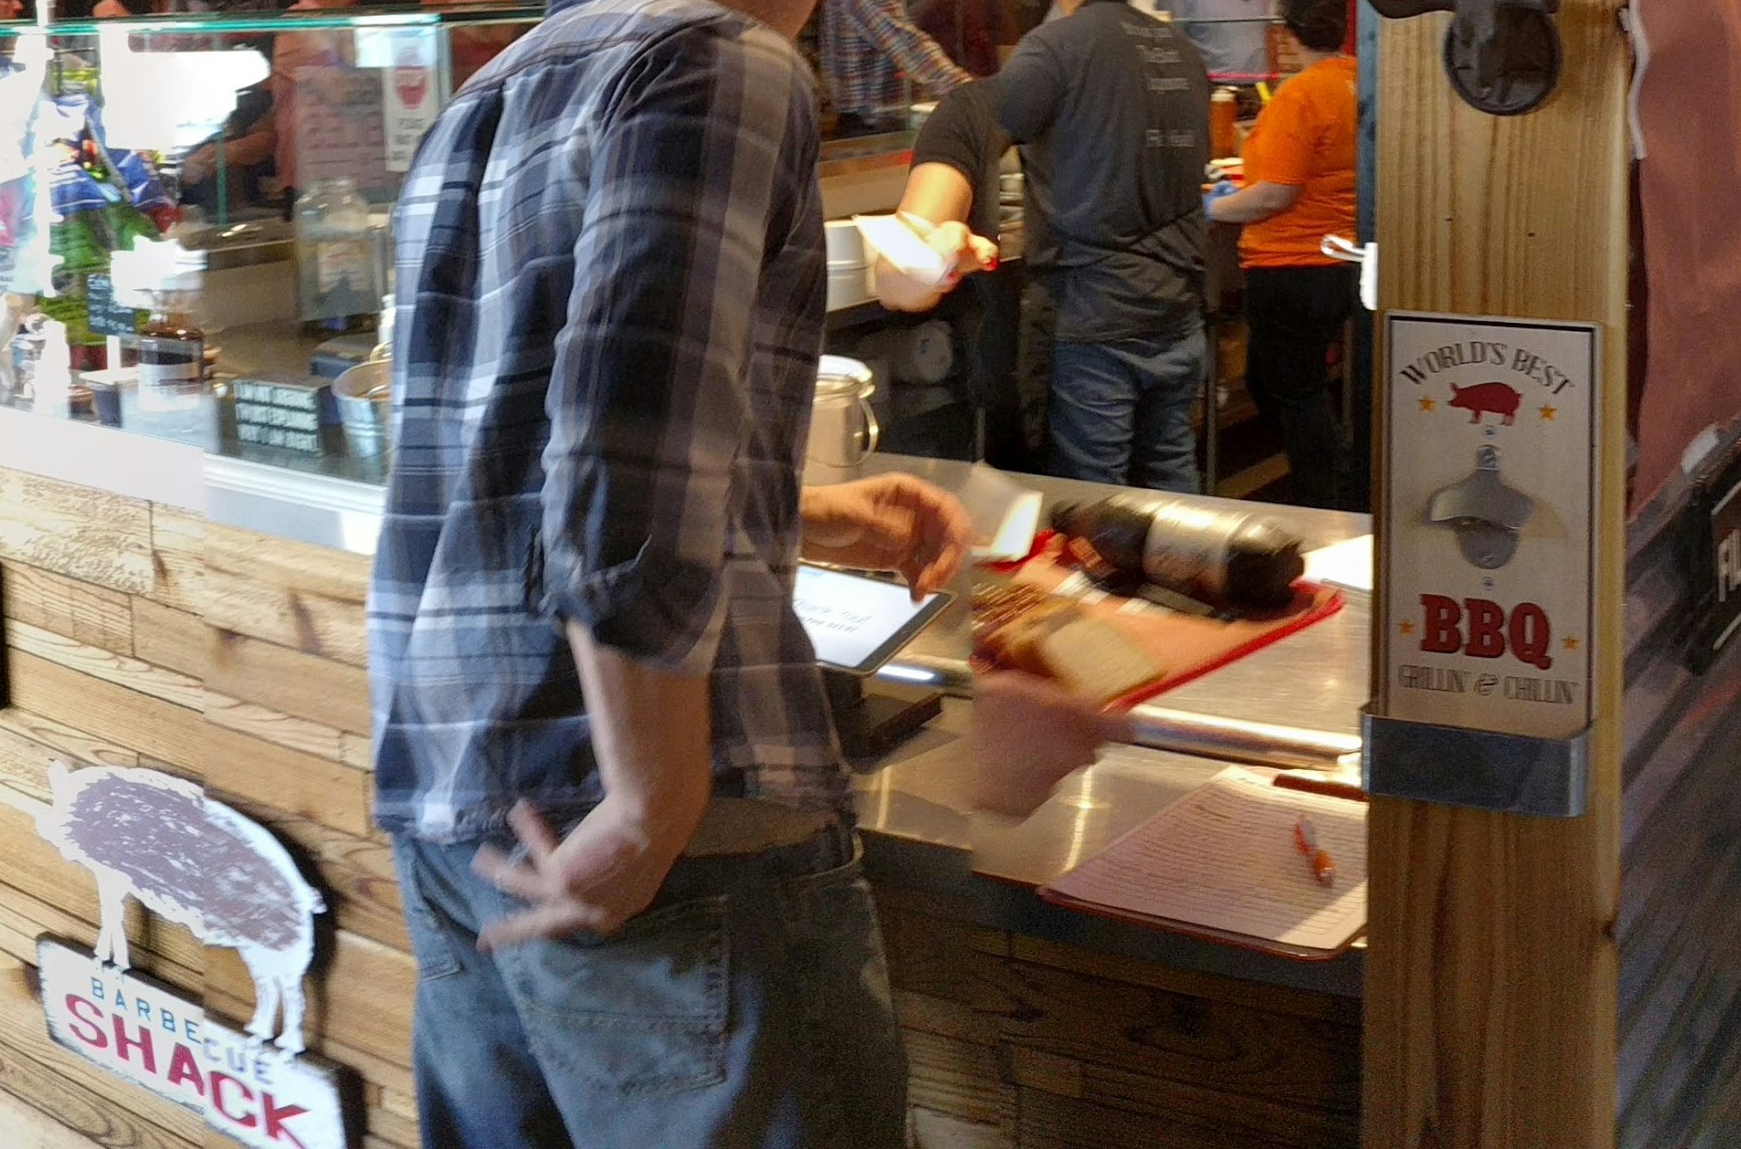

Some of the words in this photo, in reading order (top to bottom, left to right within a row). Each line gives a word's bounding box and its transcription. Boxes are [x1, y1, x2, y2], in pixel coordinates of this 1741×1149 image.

[1400, 341, 1508, 387] WORLD'S
[1510, 347, 1575, 396] BEST
[1419, 593, 1554, 670] BBQ
[1398, 663, 1470, 695] GRILLIN'
[1473, 672, 1498, 696] &
[1503, 675, 1580, 705] CHILLIN'
[91, 977, 275, 1086] BARBECUE
[65, 993, 311, 1149] SHACK
